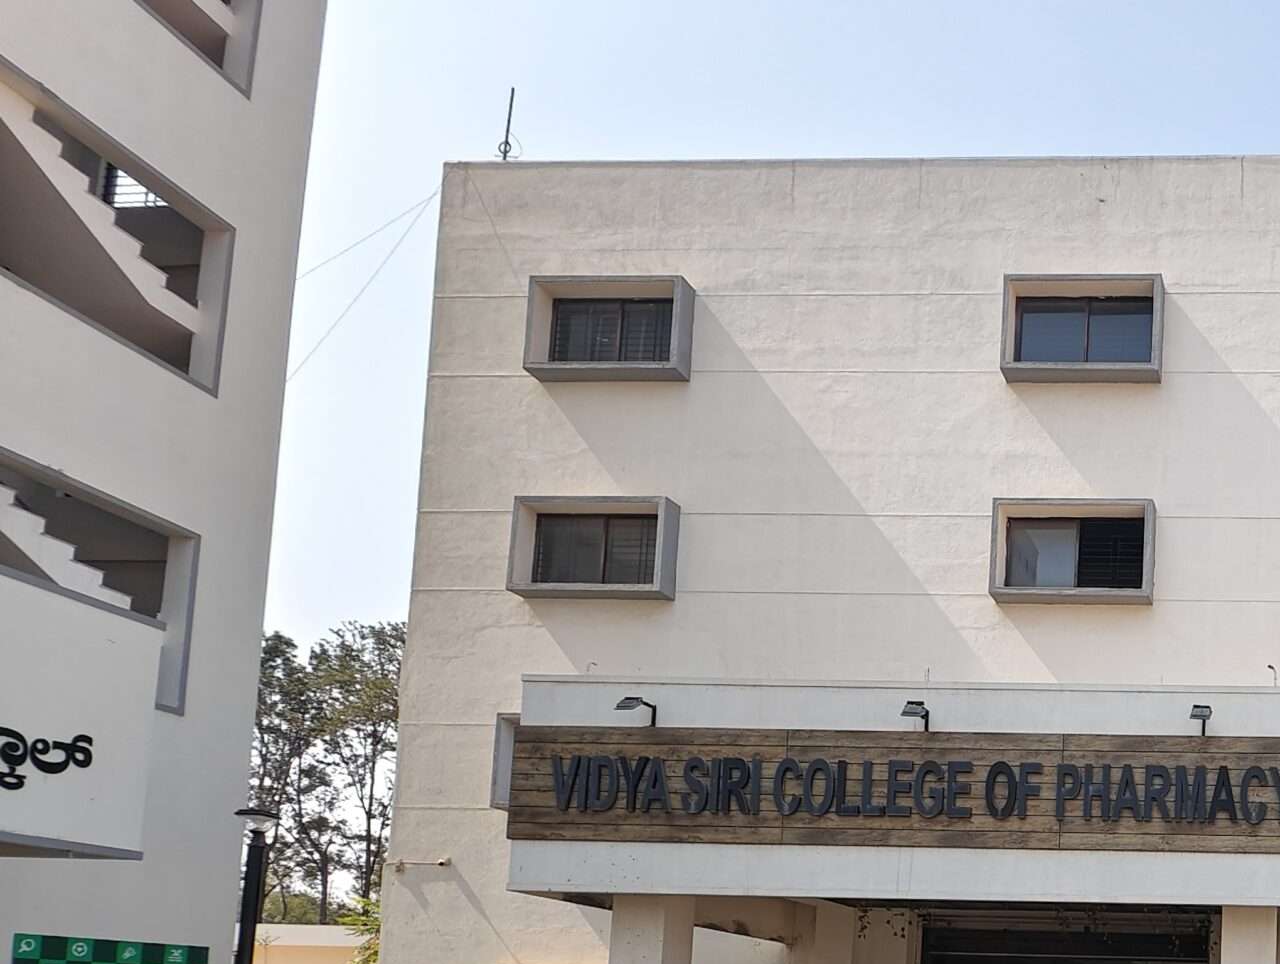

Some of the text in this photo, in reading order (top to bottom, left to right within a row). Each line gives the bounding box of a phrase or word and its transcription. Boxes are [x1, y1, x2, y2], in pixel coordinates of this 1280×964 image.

[552, 754, 672, 813] VIDYA
[680, 752, 762, 816] SIRI
[773, 757, 975, 819] COLLEGE
[985, 760, 1043, 820] OF
